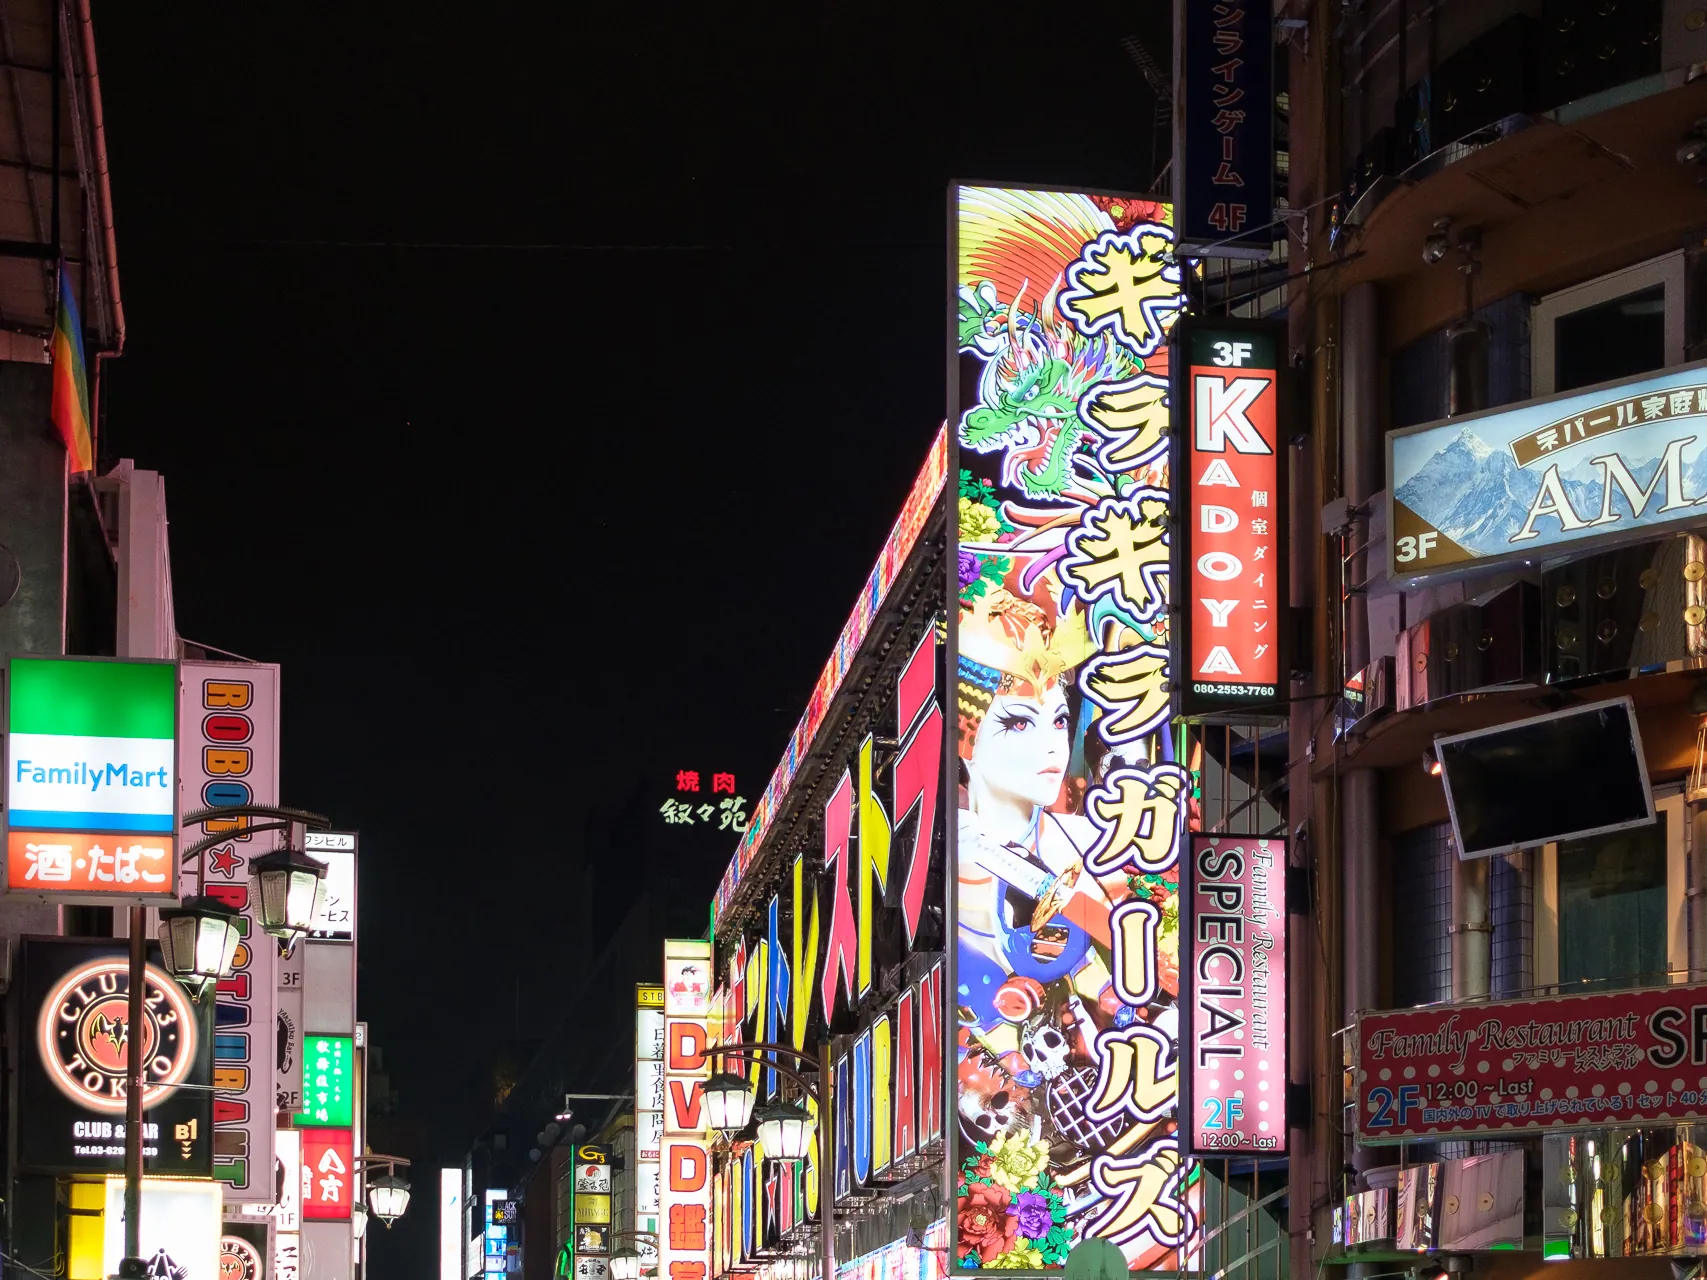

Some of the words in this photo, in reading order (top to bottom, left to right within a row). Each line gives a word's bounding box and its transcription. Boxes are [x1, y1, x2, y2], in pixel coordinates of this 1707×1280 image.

[1211, 0, 1247, 187] ンラインゲーム
[1208, 203, 1247, 232] 4F
[1213, 342, 1252, 366] 3F
[1509, 435, 1707, 543] AM
[1195, 375, 1273, 675] KADOYA
[1396, 531, 1438, 562] 3F
[1251, 489, 1268, 660] 個室ダイニング
[1194, 684, 1274, 697] 080-2553-7760
[1060, 224, 1197, 1249] ギラギラガールズ
[16, 760, 168, 792] FamilyMart
[676, 769, 735, 794] 焼肉
[25, 843, 166, 882] 酒・たばこ
[1241, 848, 1279, 928] Family
[1197, 847, 1247, 1070] SPECIAL
[282, 972, 300, 986] 3F
[1251, 931, 1275, 1052] Restaurant
[61, 973, 177, 1026] CLU23
[1369, 1015, 1470, 1070] Family
[1477, 1012, 1640, 1051] Restaurant
[1513, 1043, 1639, 1064] ファミリーレストラン
[1574, 1055, 1639, 1073] スペシャル
[1201, 1095, 1243, 1131] 2F
[1367, 1085, 1420, 1128] 2F
[1426, 1081, 1478, 1100] 12:00
[1499, 1079, 1534, 1095] Last
[73, 1121, 113, 1138] CLUB
[175, 1119, 198, 1140] B1
[1201, 1133, 1239, 1147] 12:00
[1253, 1133, 1277, 1148] Last
